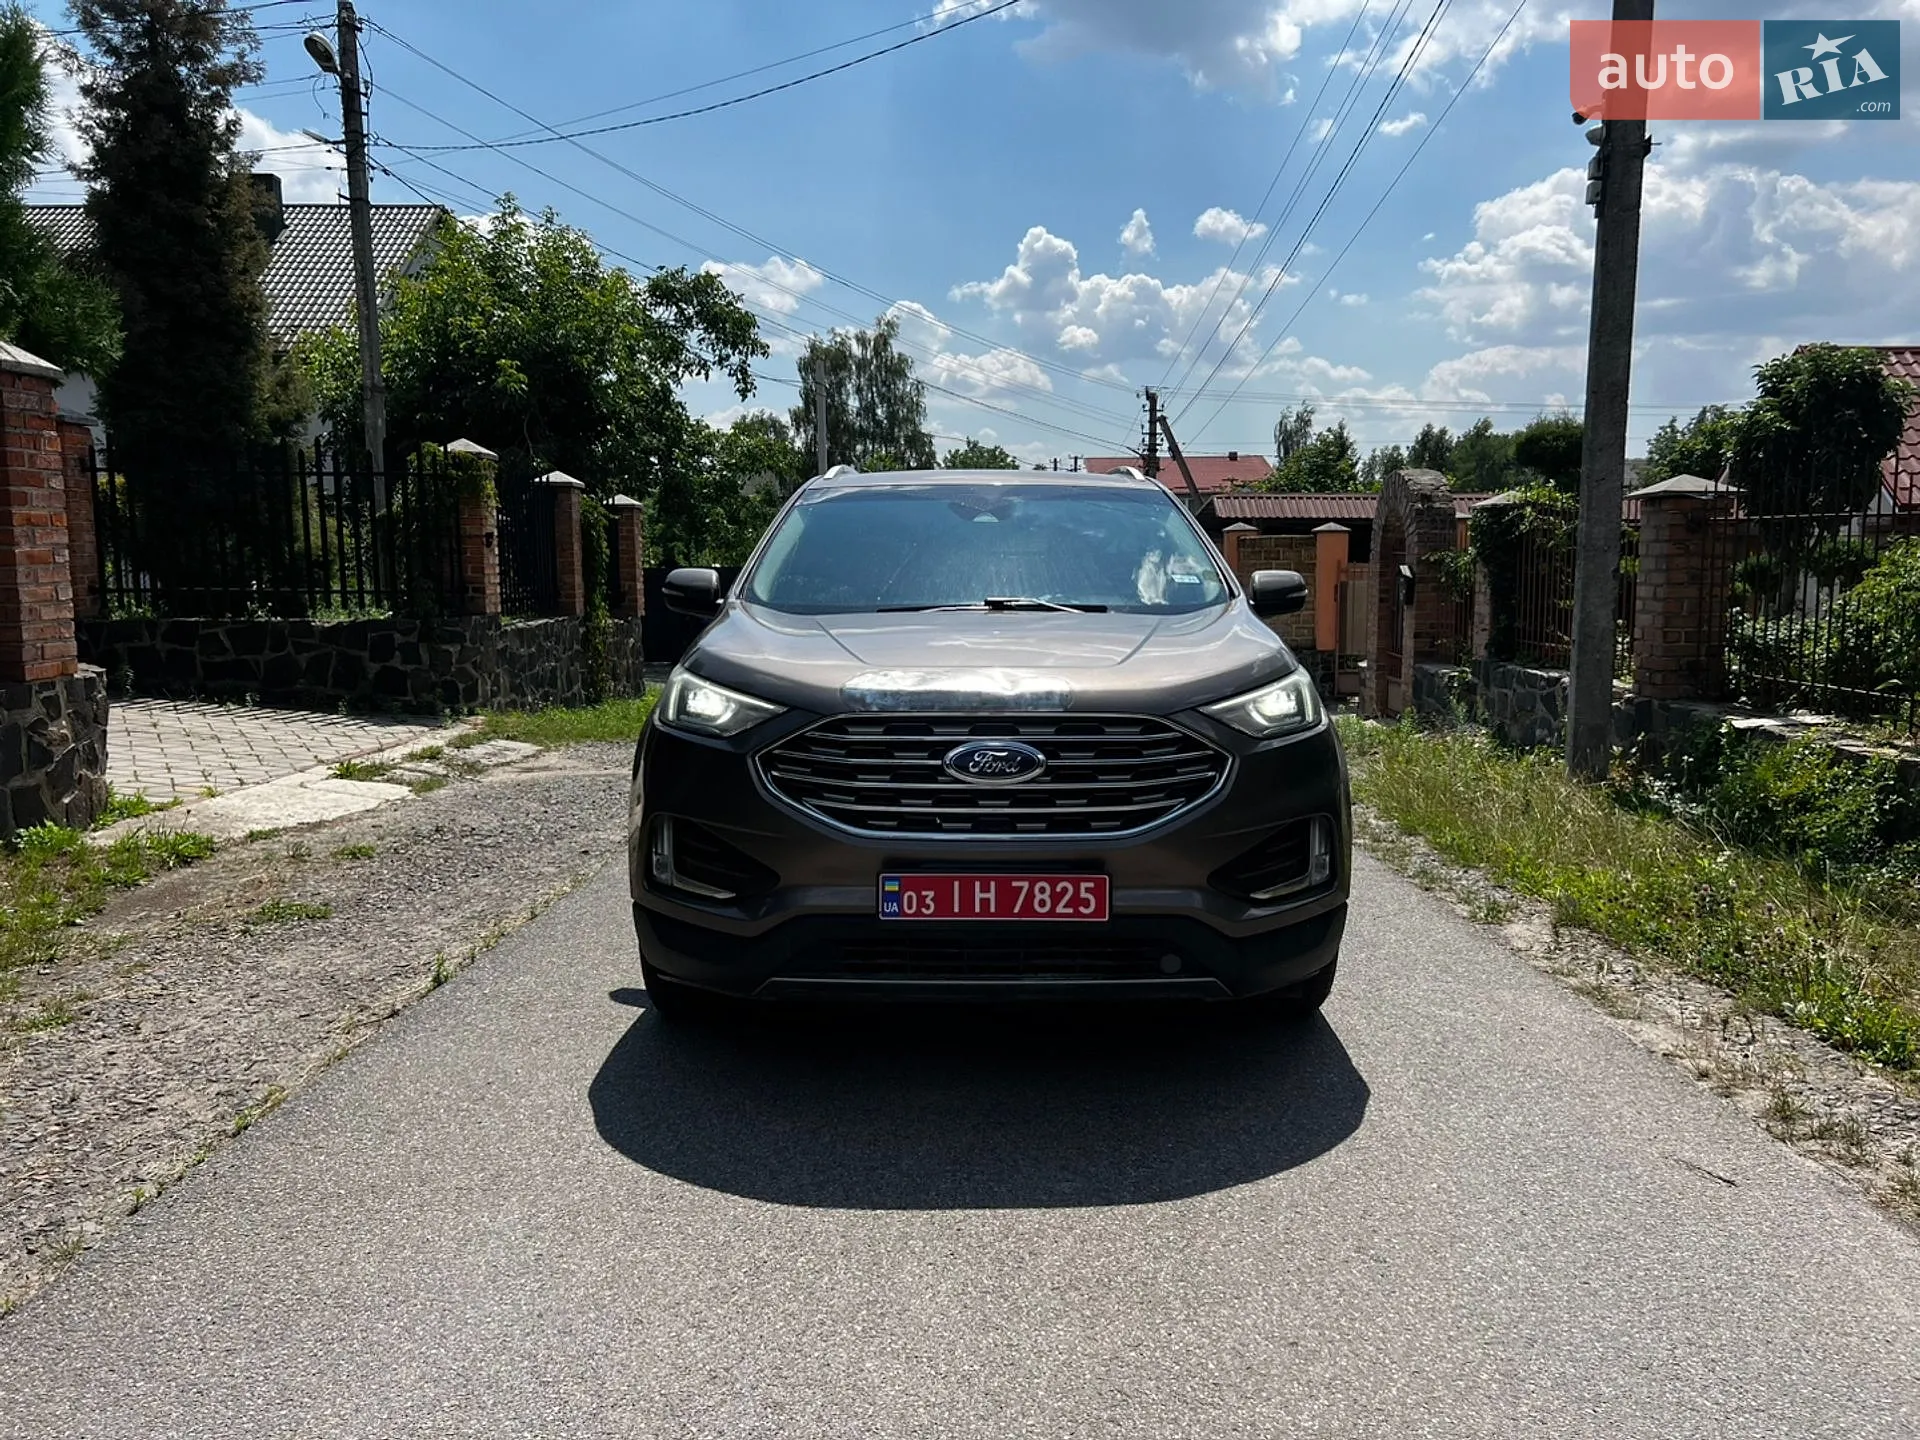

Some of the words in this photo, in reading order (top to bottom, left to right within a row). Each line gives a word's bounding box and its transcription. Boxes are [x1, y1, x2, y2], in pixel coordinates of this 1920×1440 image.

[968, 750, 1021, 773] Ford
[883, 901, 899, 913] UA
[903, 890, 935, 915] 03
[1011, 881, 1096, 914] 7825
